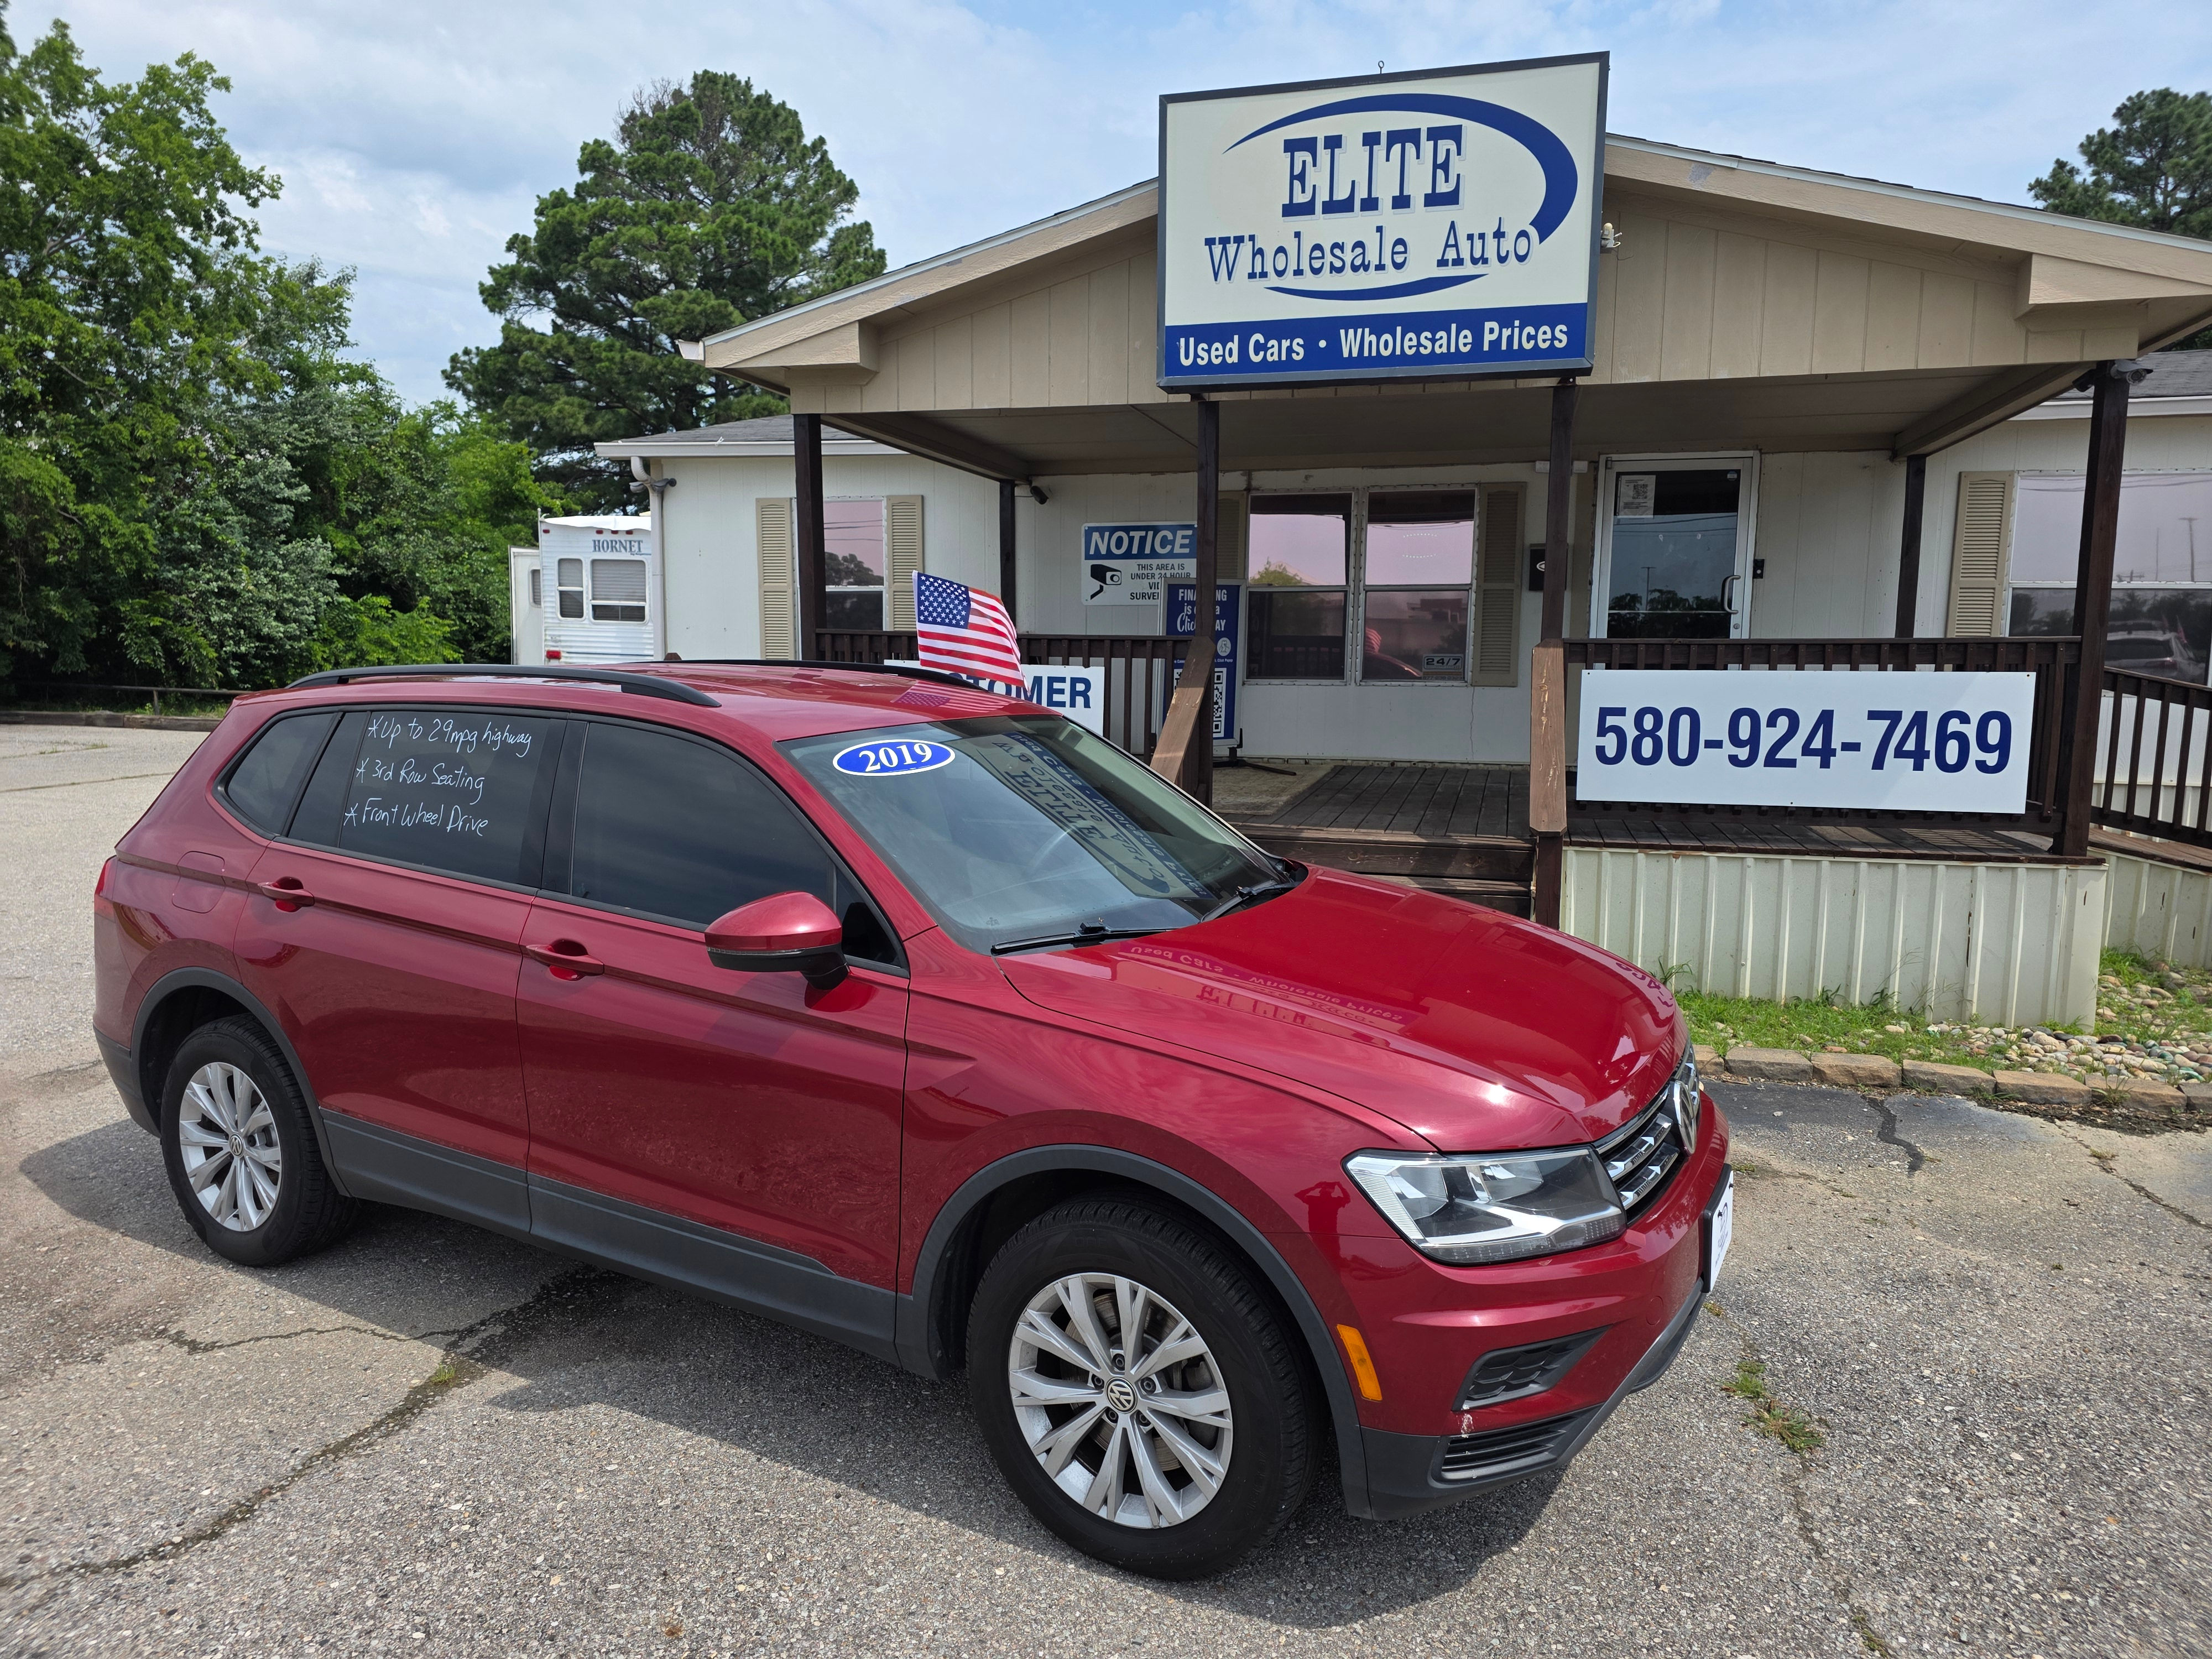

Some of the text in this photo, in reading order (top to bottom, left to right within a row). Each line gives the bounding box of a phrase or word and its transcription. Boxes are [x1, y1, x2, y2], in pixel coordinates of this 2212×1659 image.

[1282, 124, 1466, 220] ELITE
[1204, 217, 1532, 283] Wholesale Auto
[1179, 320, 1568, 366] Used Cars Wholesale Prices
[592, 540, 643, 553] HORNET
[1089, 530, 1193, 555] NOTICE
[1177, 612, 1196, 632] Clic
[1184, 603, 1192, 614] is
[380, 718, 401, 749] Up
[408, 718, 422, 739] to
[482, 722, 531, 758] highway
[859, 743, 932, 772] 2019
[1595, 706, 2012, 774] 580-924-7469
[373, 758, 485, 805] 3rd Row Seating
[362, 797, 489, 836] Front Wheel Drive
